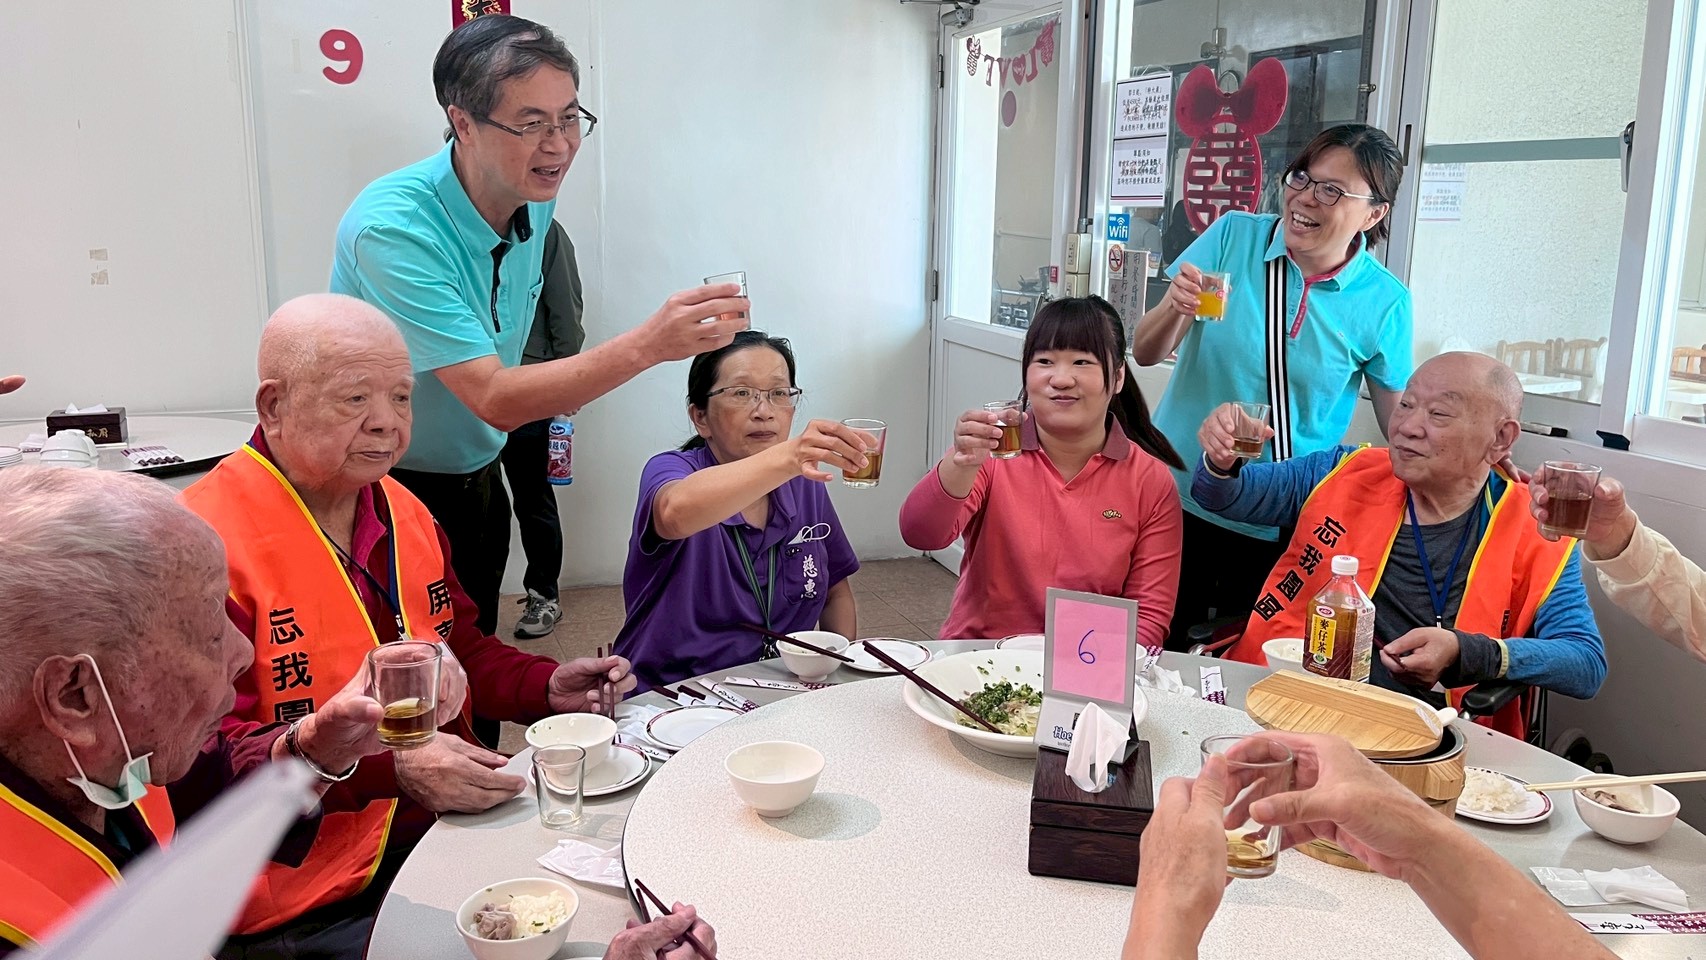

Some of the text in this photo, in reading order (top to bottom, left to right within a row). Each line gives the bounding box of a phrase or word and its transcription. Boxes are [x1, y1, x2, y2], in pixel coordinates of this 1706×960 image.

[319, 28, 364, 85] 9
[1109, 225, 1128, 238] Wifi
[1077, 629, 1097, 665] 6
[1316, 619, 1330, 654] 麥仔茶
[268, 607, 316, 723] 忘我園
[1053, 725, 1073, 744] Hoe
